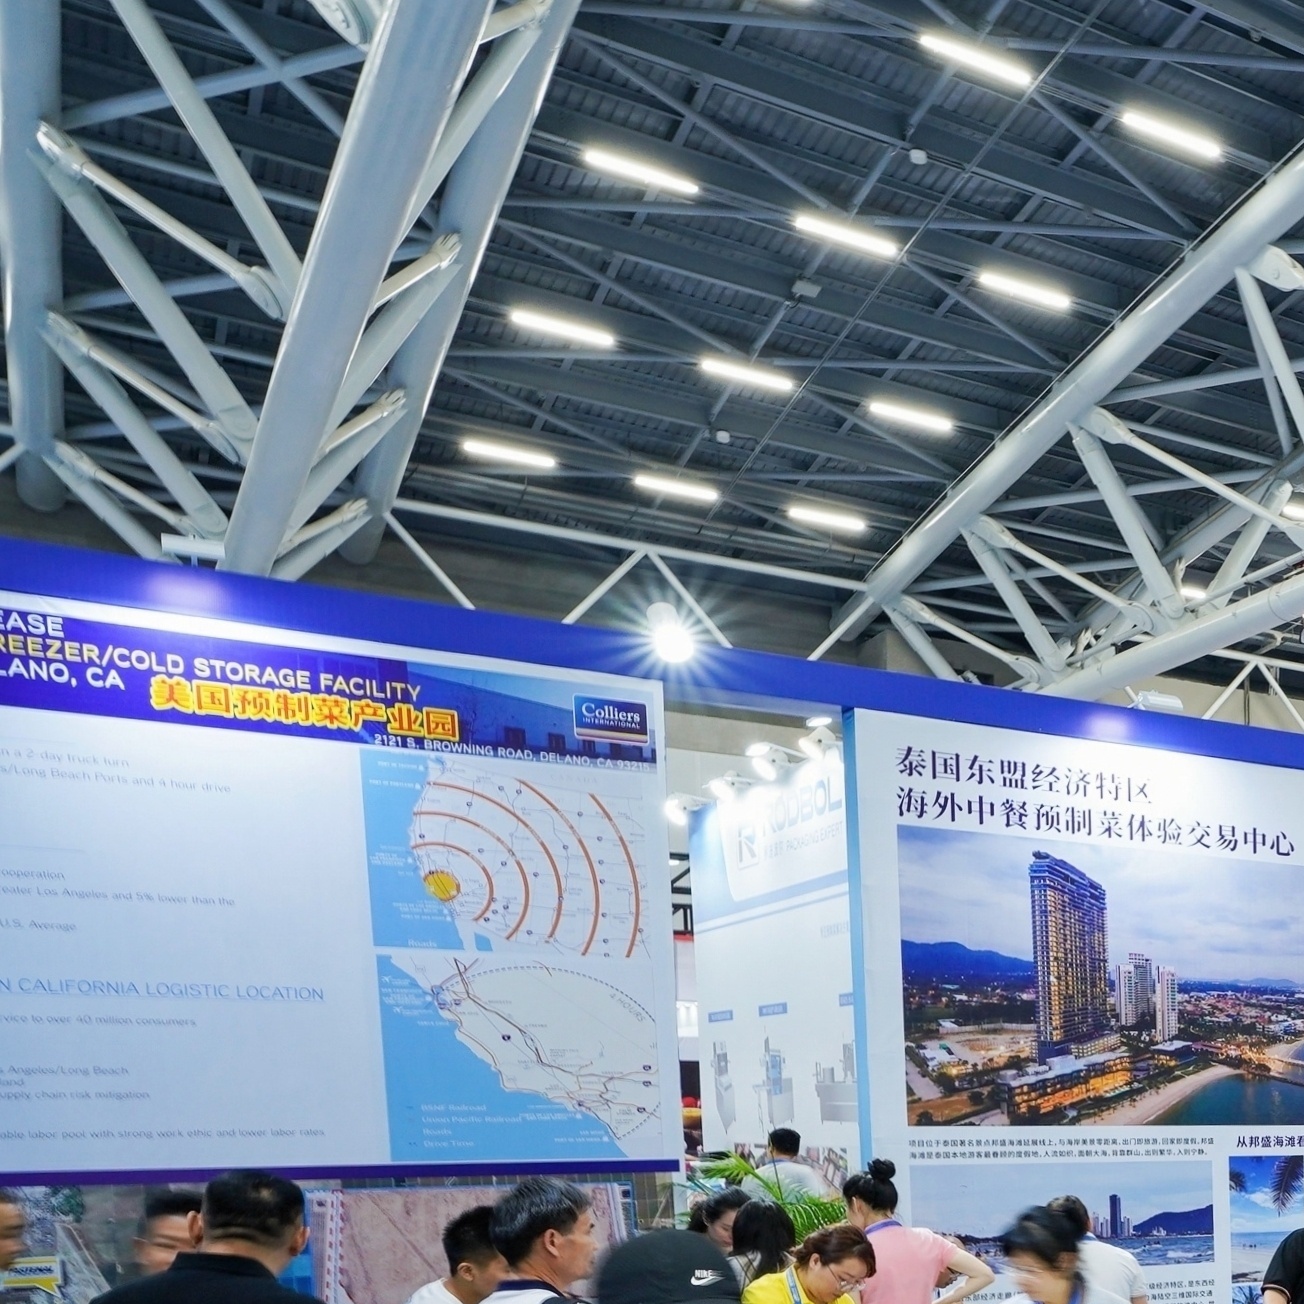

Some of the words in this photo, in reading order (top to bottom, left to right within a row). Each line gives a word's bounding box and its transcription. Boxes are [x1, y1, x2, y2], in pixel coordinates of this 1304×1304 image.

[0, 610, 65, 638] ASE
[0, 634, 185, 675] EEZER/COLD
[194, 657, 310, 690] STORAGE
[320, 674, 421, 702] FACILITY
[86, 667, 125, 690] CA
[150, 674, 459, 742] 美国预制菜产业园
[581, 701, 641, 723] Colliers
[582, 716, 641, 730] INTERNATIONAL
[374, 734, 402, 747] 2121
[424, 739, 494, 757] BROWNING
[497, 746, 537, 763] ROAD,
[540, 751, 593, 769] DELANO,
[597, 758, 613, 769] CA
[617, 758, 650, 773] 93215
[896, 745, 1152, 804] 泰国东盟经济特区
[897, 786, 1295, 857] 海外中餐预制菜体验交易中心
[18, 978, 141, 997] CALIFORNIA
[146, 982, 230, 998] LOGISTIC
[236, 985, 324, 1001] LOCATION
